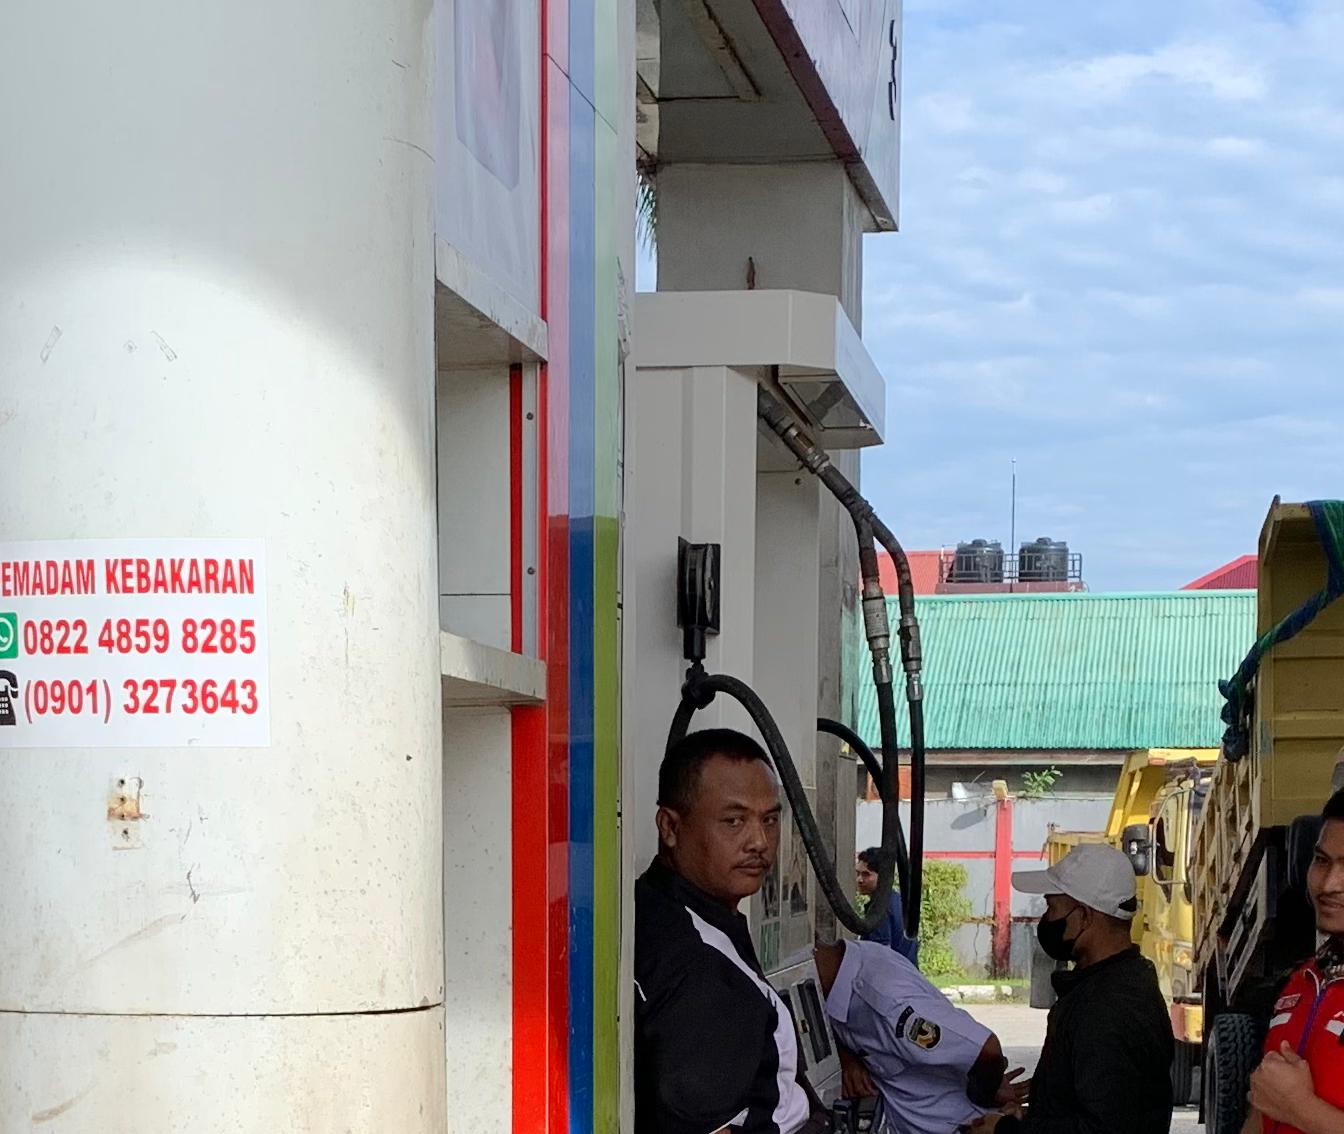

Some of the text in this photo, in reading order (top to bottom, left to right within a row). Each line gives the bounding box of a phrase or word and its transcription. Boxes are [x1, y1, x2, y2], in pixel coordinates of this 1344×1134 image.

[105, 558, 255, 595] KEBAKARAN
[23, 618, 256, 655] 0822 4859 8285
[24, 679, 259, 725] (0901) 3273643
